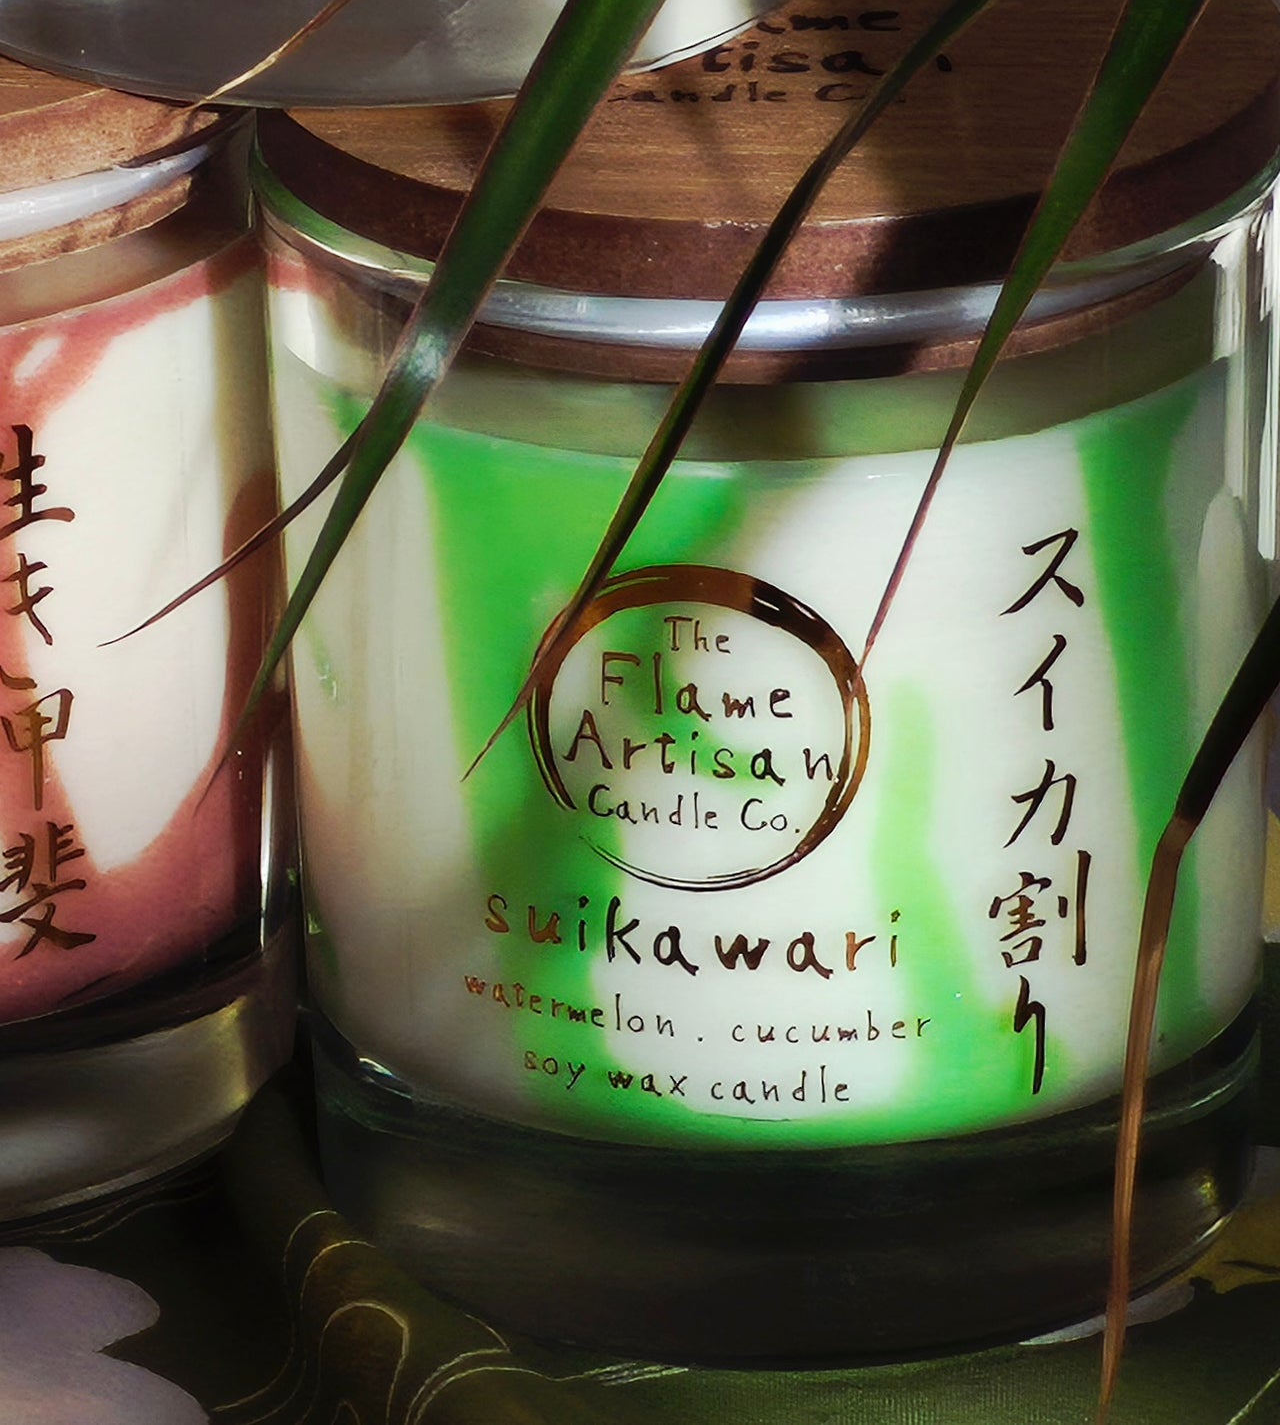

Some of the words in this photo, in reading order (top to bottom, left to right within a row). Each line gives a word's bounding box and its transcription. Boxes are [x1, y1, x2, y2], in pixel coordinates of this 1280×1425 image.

[701, 41, 952, 76] tisa
[662, 615, 731, 655] The
[599, 651, 794, 721] Flame
[563, 709, 837, 786] Artisan
[587, 783, 719, 830] Candle
[740, 797, 801, 834] Co.
[987, 526, 1093, 1096] スイカ割り
[483, 892, 903, 981] suikawari
[463, 973, 676, 1039] watermelon
[730, 1009, 932, 1043] cucumber
[522, 1047, 586, 1090] soy
[607, 1066, 688, 1098] wax
[710, 1064, 851, 1104] candle
